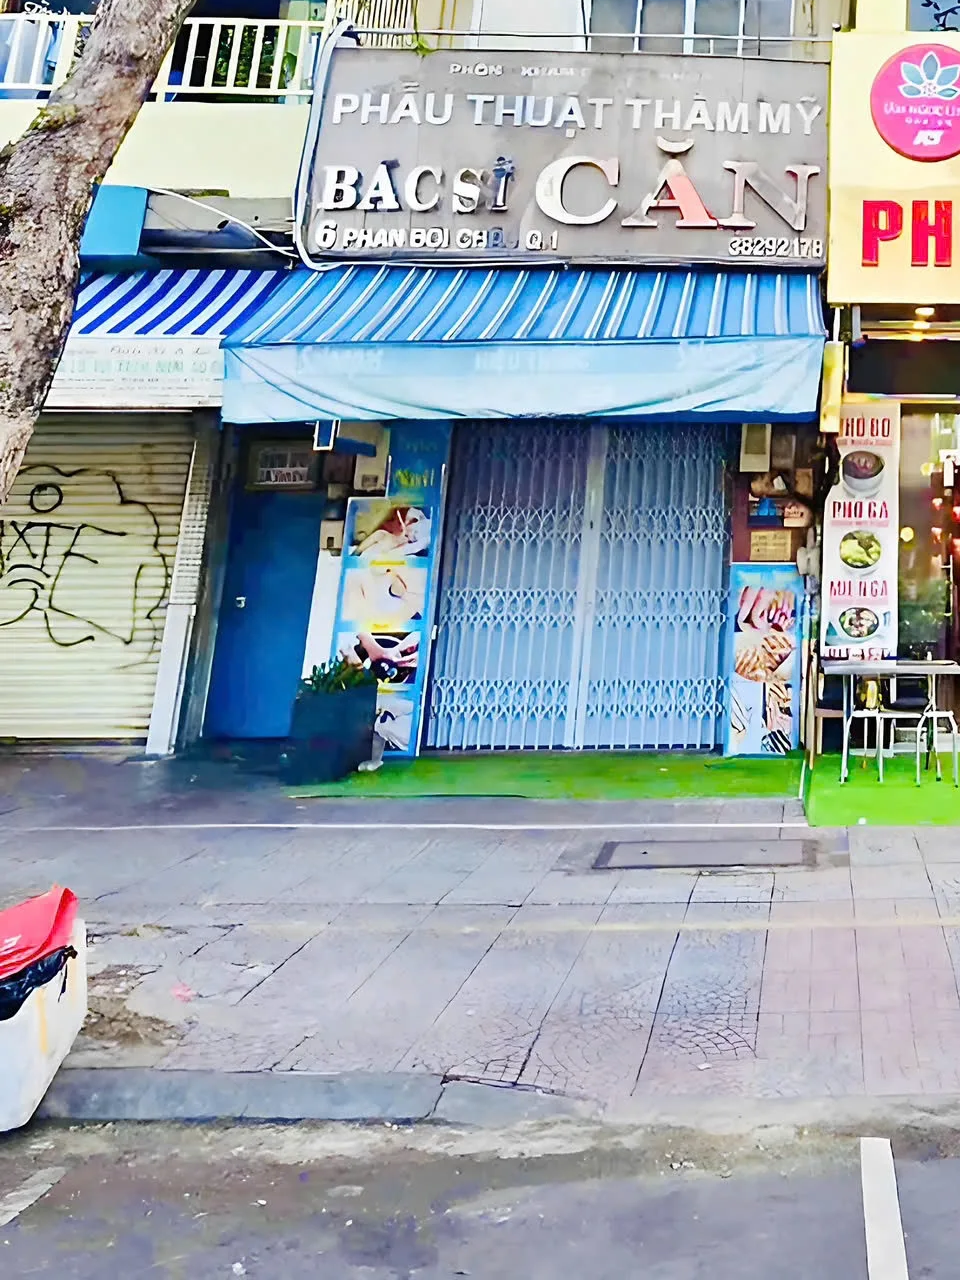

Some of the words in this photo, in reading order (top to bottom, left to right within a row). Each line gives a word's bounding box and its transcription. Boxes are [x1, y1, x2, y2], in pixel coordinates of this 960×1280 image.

[332, 81, 454, 125] PHẪU
[467, 93, 613, 138] THUẬT
[757, 96, 823, 135] MỸ
[535, 135, 821, 232] CĂN
[315, 220, 338, 249] 6
